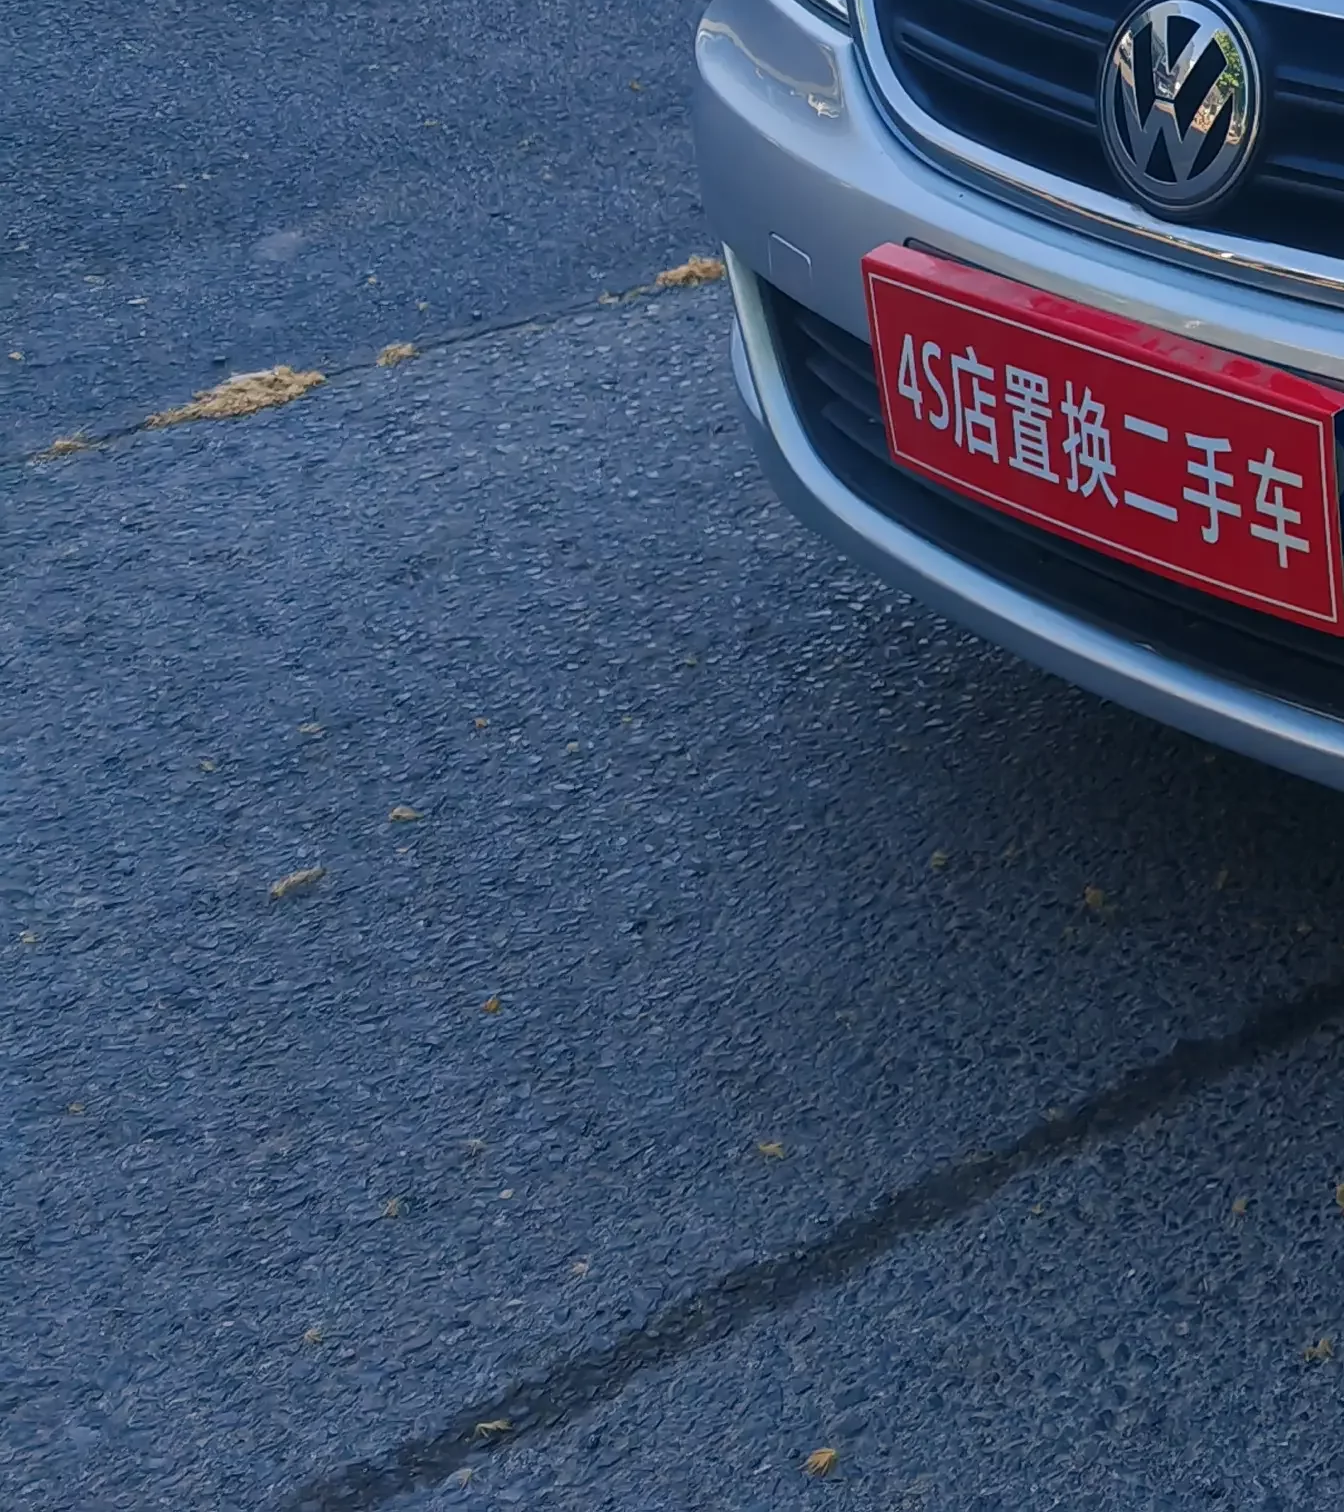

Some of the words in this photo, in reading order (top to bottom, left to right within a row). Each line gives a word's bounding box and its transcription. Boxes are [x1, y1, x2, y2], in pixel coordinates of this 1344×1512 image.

[897, 333, 1310, 569] 4S店置换二手车
